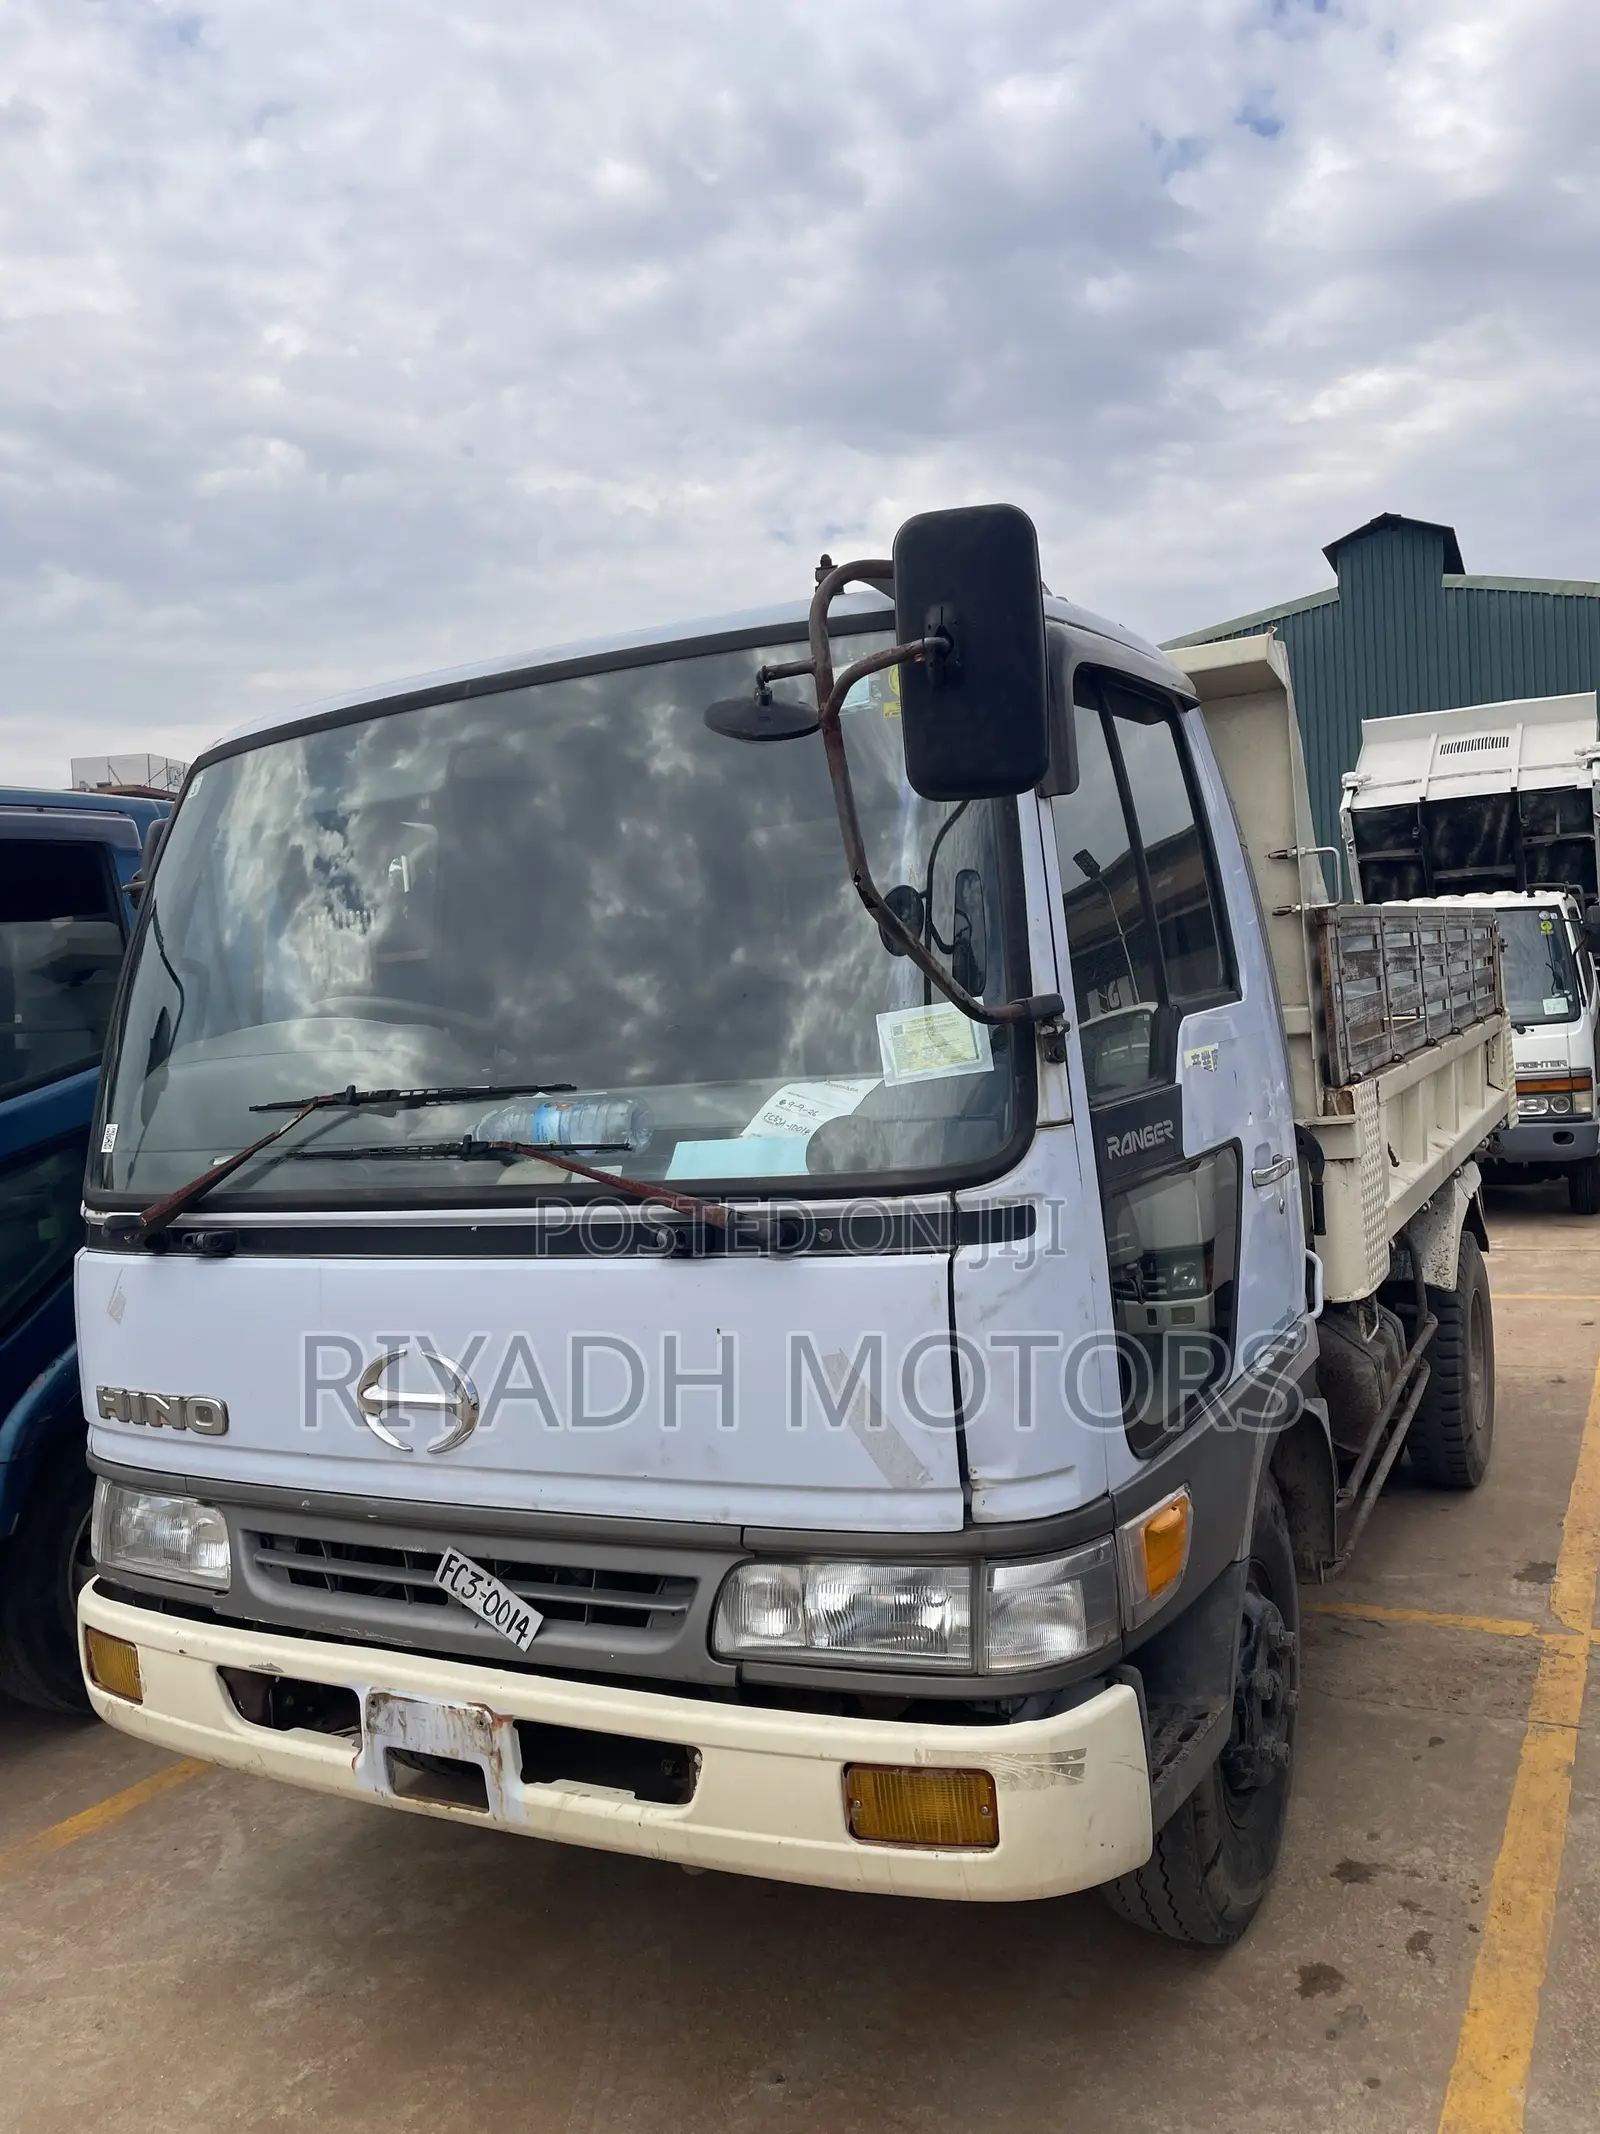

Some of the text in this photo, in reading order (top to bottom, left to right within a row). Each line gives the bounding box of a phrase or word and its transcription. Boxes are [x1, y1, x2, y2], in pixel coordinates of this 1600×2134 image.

[1515, 1059, 1568, 1069] FIGHTER
[1106, 1119, 1175, 1160] RANGER
[96, 1384, 229, 1436] HINO
